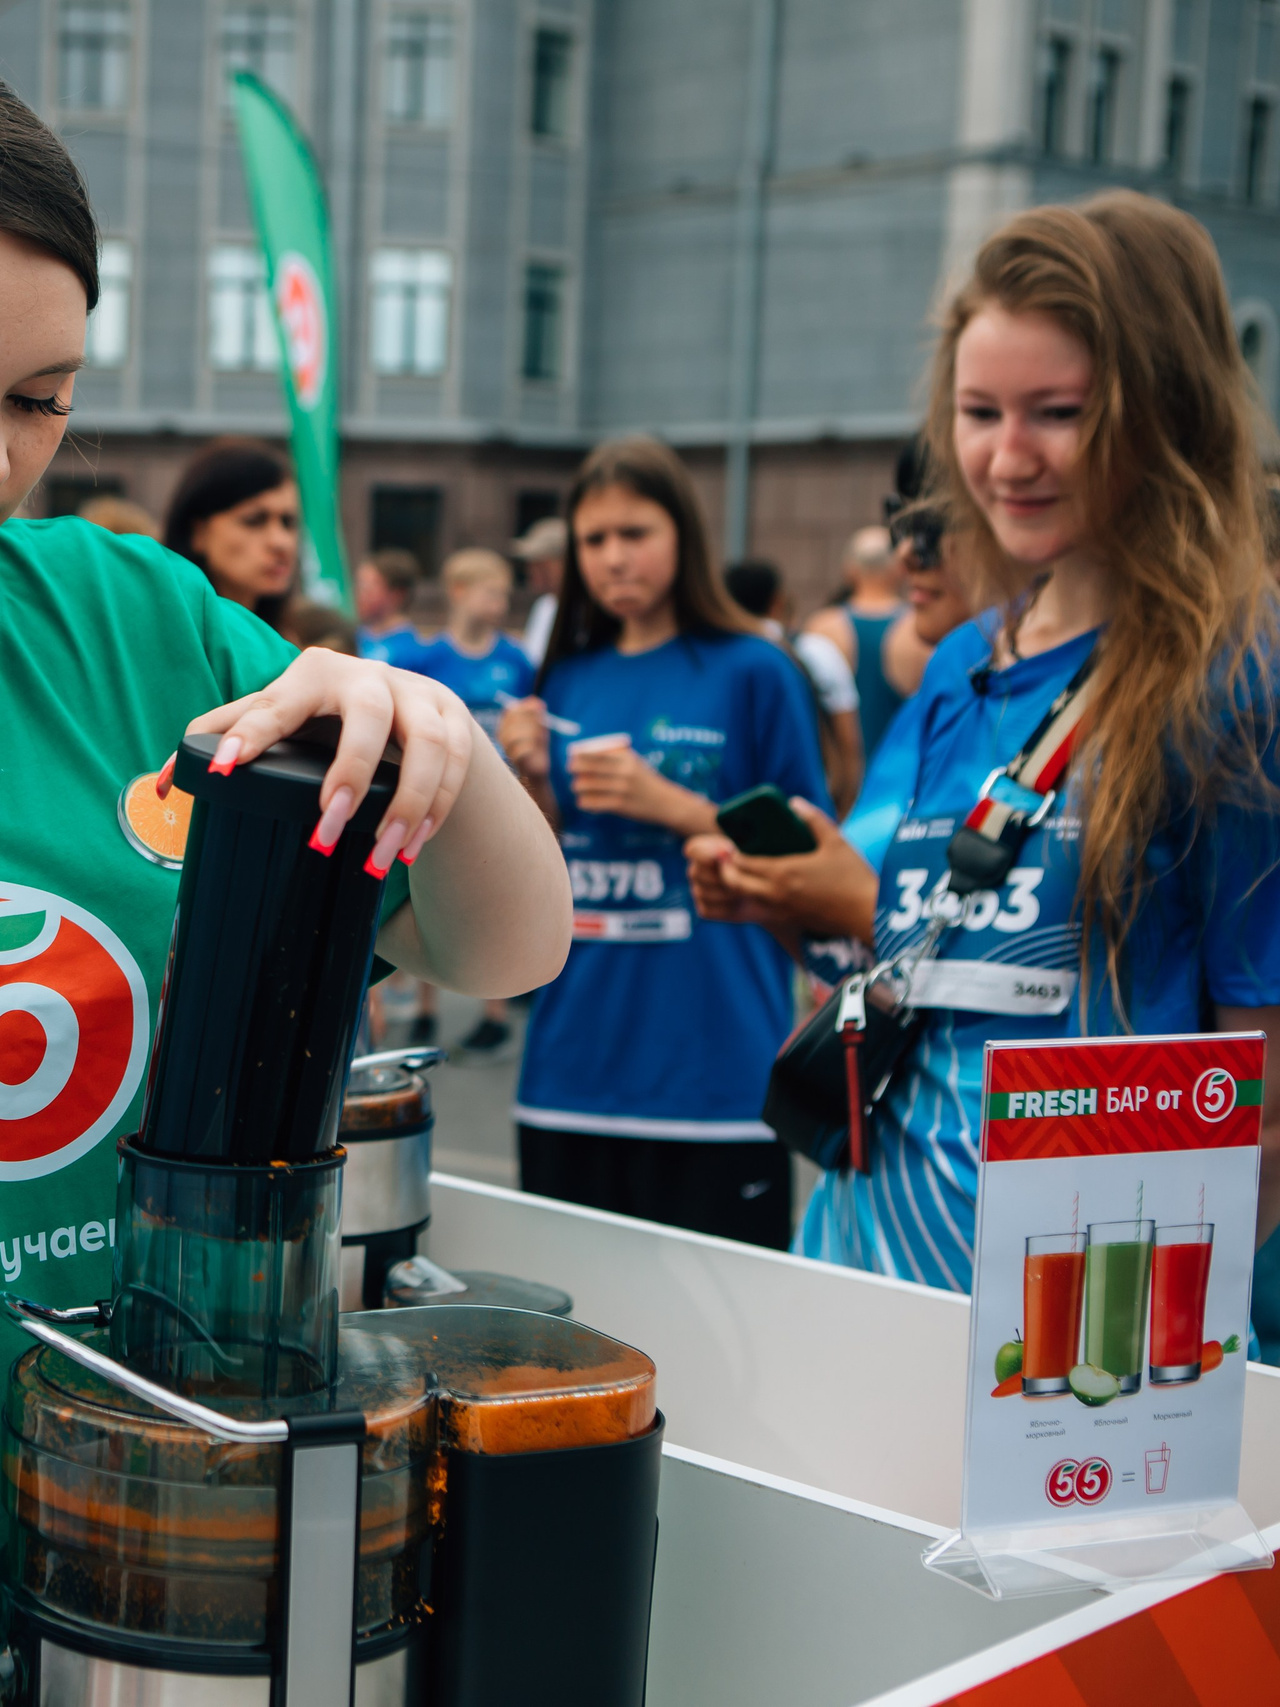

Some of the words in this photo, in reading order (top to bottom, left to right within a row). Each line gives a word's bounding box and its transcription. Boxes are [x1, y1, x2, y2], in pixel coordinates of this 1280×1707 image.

[1013, 980, 1062, 1000] 3463
[1007, 1087, 1098, 1119] FRESH
[1106, 1085, 1149, 1114] БАР
[1155, 1089, 1183, 1111] от
[1152, 1409, 1193, 1422] Морковный
[1029, 1418, 1063, 1429] Яблочно-
[1093, 1416, 1129, 1428] Яблочный
[1025, 1428, 1066, 1440] морковный
